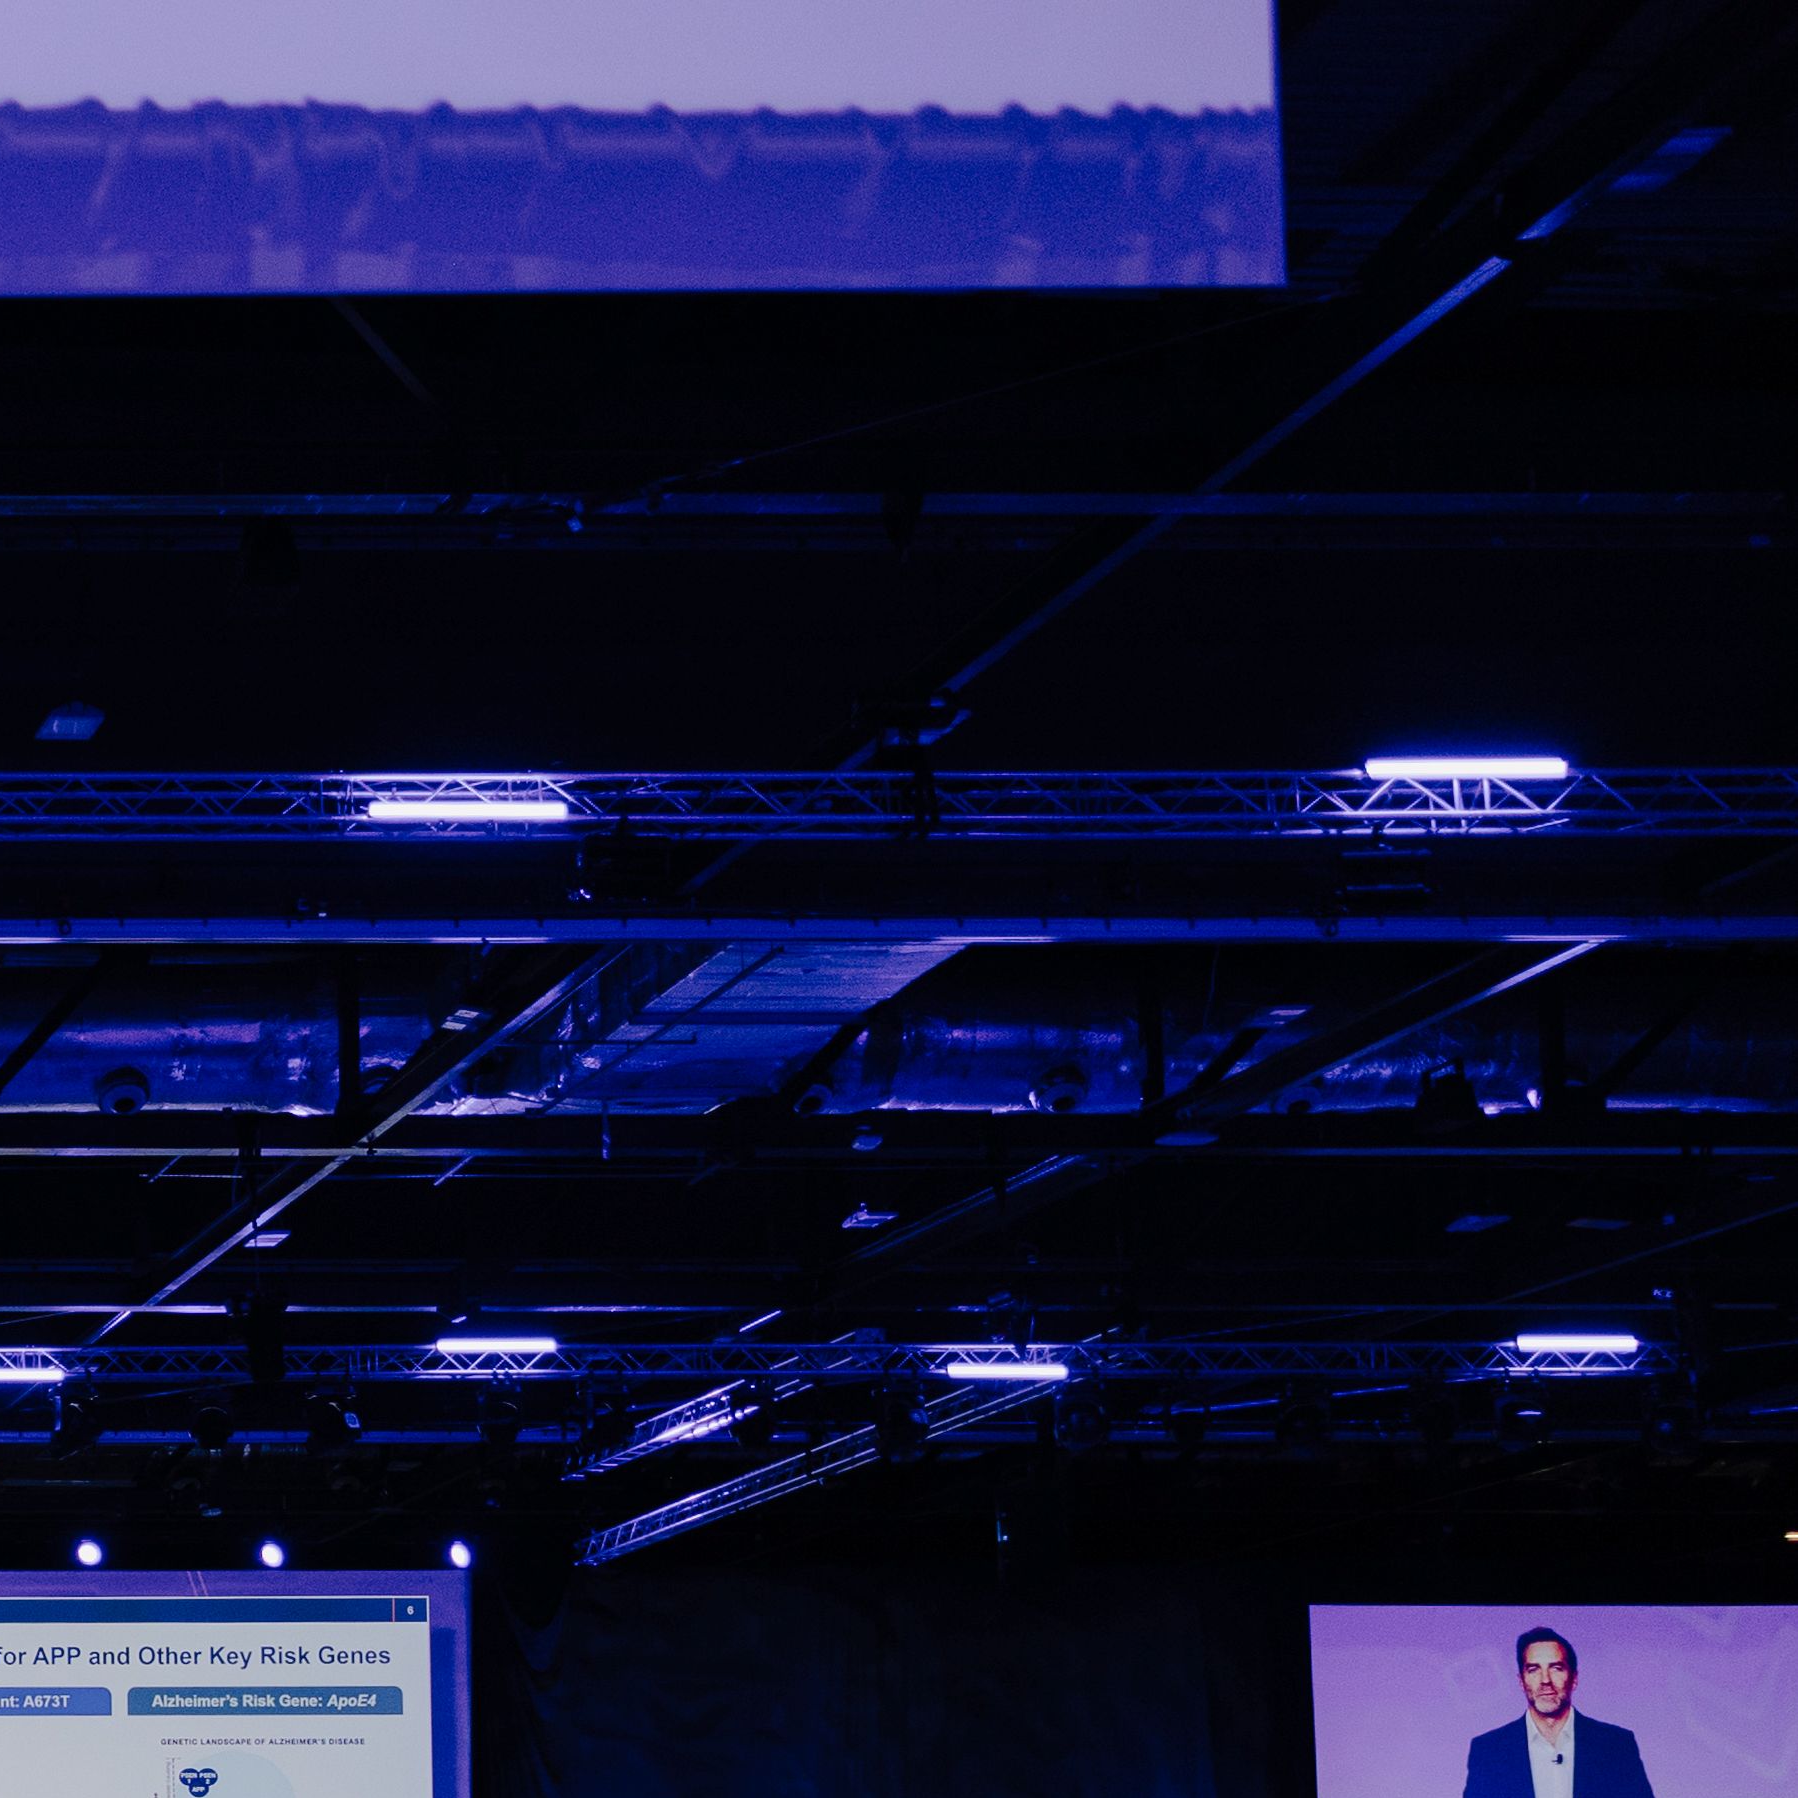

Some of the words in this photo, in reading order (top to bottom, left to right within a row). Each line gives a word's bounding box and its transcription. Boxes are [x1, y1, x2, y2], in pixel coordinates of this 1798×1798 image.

[407, 1606, 414, 1615] 6
[33, 1647, 81, 1665] APP
[89, 1647, 130, 1665] and
[139, 1646, 202, 1665] Other
[210, 1646, 252, 1670] Key
[261, 1646, 310, 1664] Risk
[318, 1646, 390, 1664] Genes
[23, 1695, 70, 1708] A673T
[152, 1694, 239, 1707] Alzheimer's
[242, 1694, 276, 1707] Risk
[279, 1694, 323, 1707] Gene:
[326, 1694, 377, 1710] ApoE4
